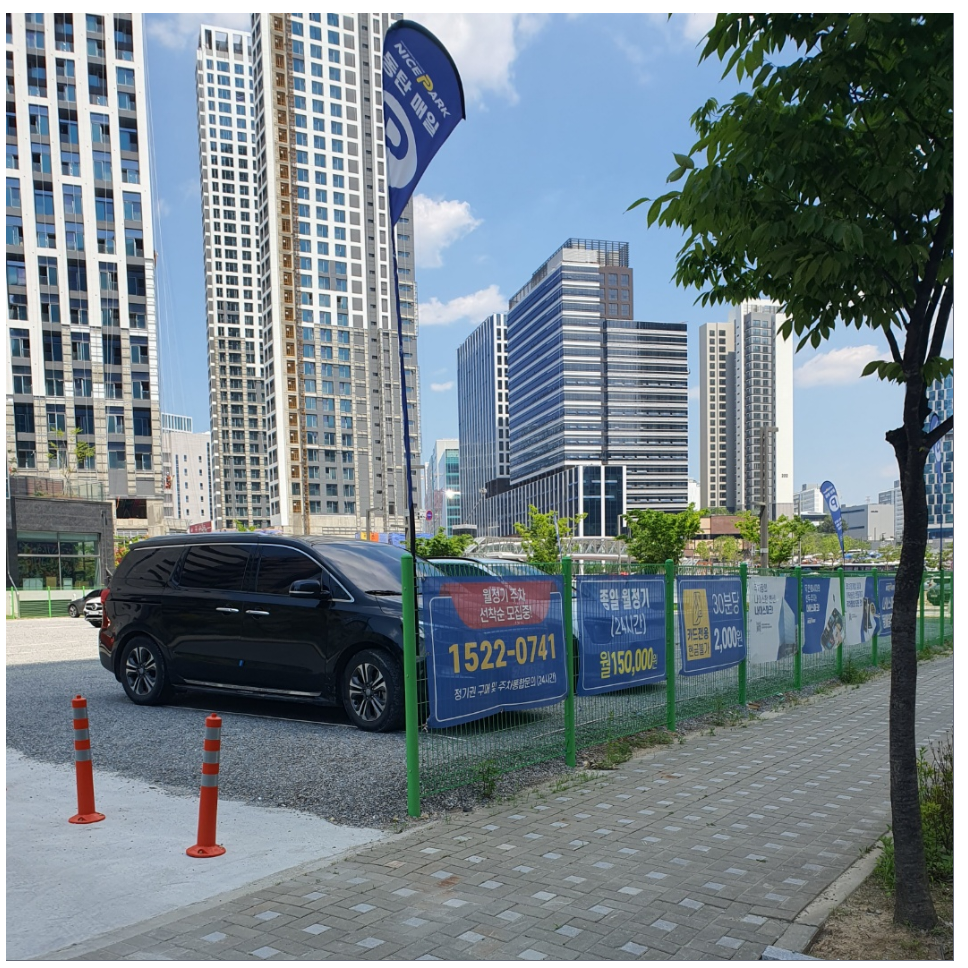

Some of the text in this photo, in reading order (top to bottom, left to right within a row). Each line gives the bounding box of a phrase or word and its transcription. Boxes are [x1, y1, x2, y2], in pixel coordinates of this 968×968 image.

[394, 43, 451, 118] NICEPARK
[383, 51, 440, 138] 동탄 매일
[482, 587, 526, 604] 월정기 주차
[599, 587, 650, 611] 종일 월정기
[712, 591, 740, 615] 30분당
[479, 607, 505, 623] 선착순
[610, 613, 647, 638] (24시간)
[713, 625, 743, 653] 2,000원
[448, 633, 556, 674] 1522-0741
[599, 647, 658, 679] 월150,000원
[454, 685, 477, 701] 정기권
